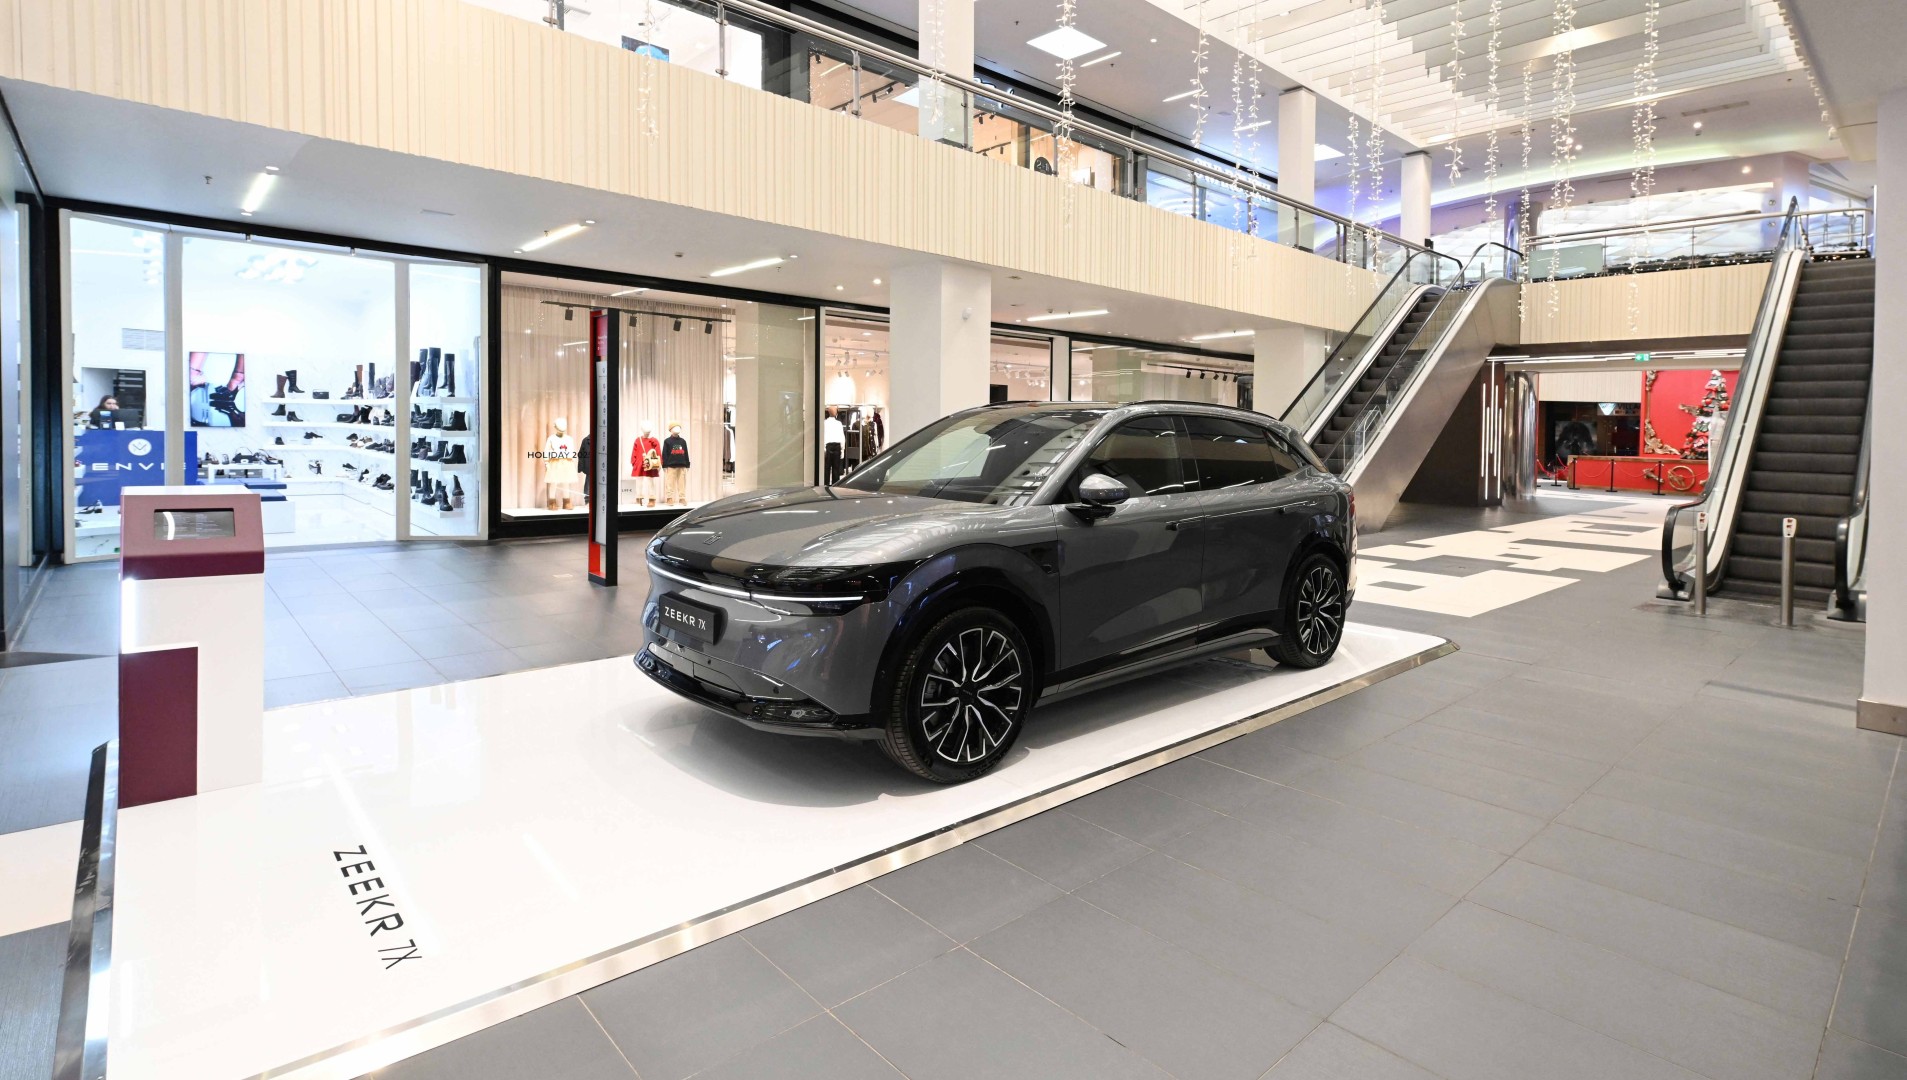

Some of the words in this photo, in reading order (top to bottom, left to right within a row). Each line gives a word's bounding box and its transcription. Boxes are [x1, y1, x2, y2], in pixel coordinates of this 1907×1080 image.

[527, 451, 570, 459] HOLIDAY
[664, 606, 696, 627] ZEEKR
[698, 618, 706, 630] 7X
[333, 844, 404, 937] ZEEKR
[378, 939, 422, 970] 7X
